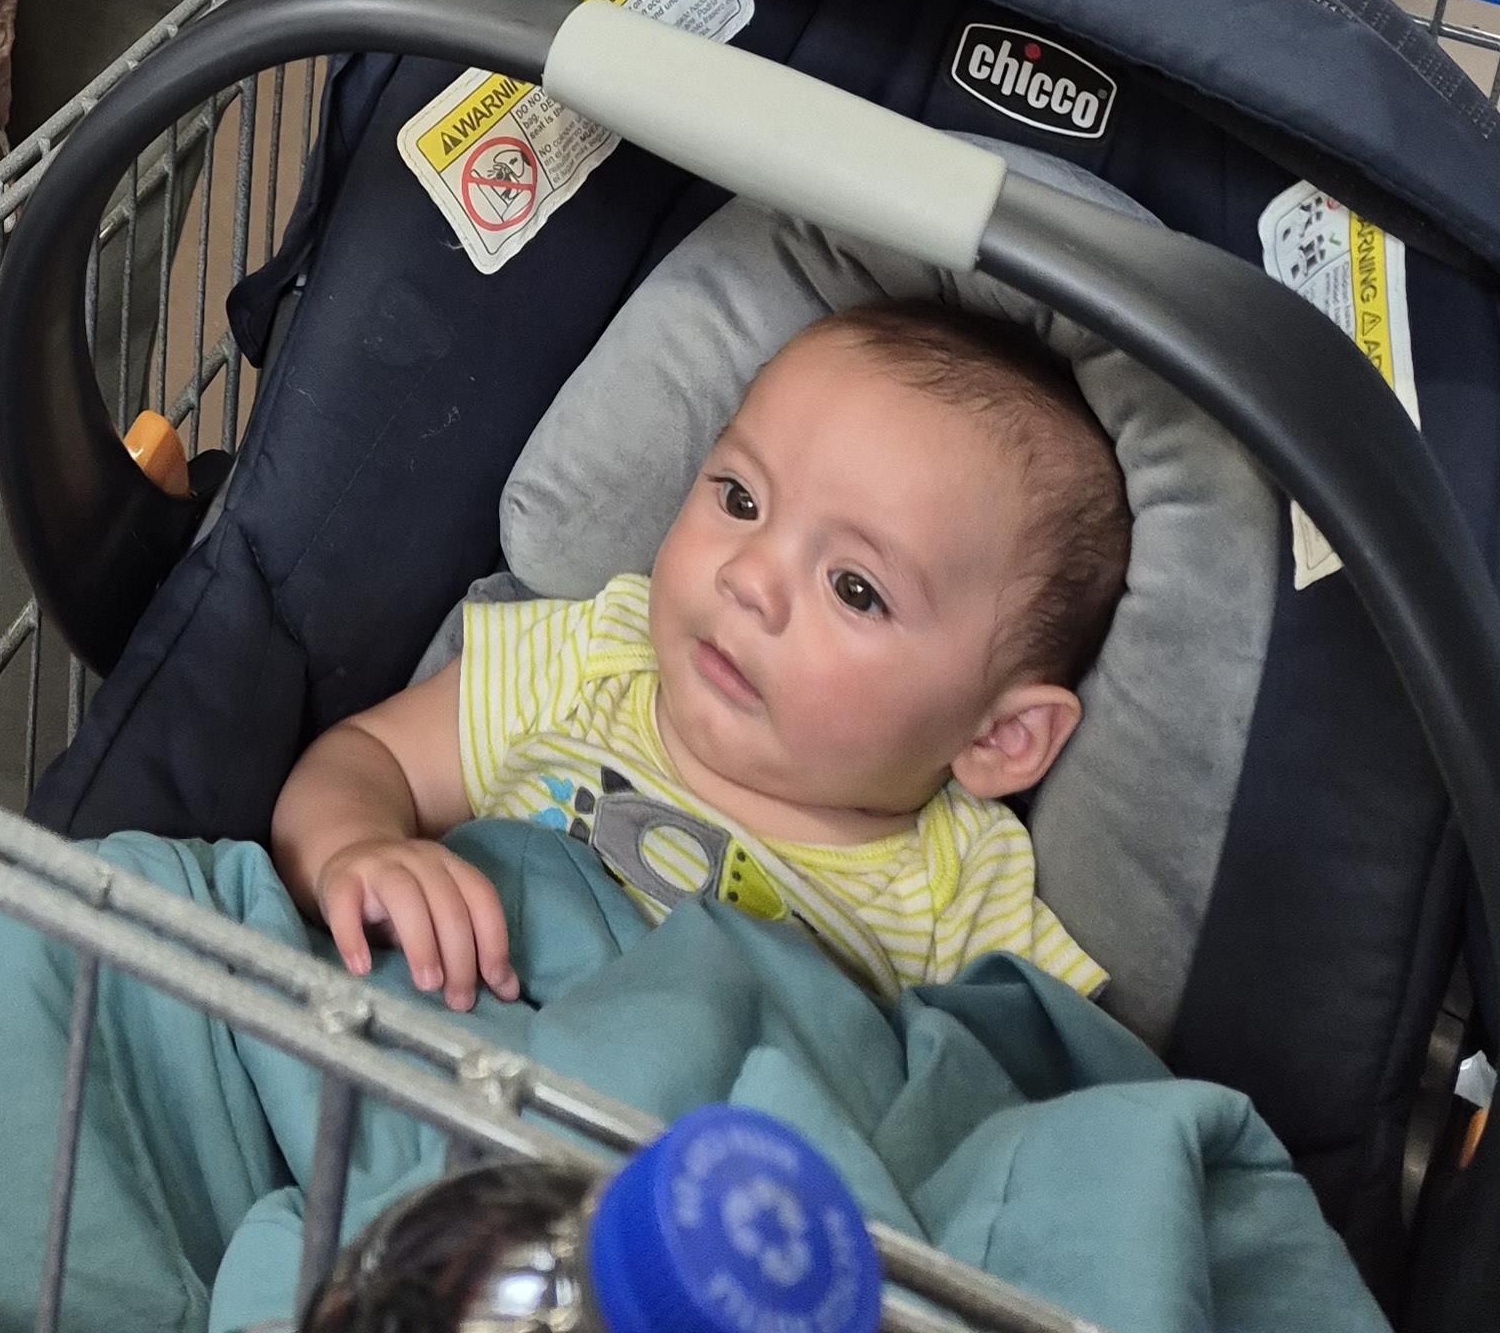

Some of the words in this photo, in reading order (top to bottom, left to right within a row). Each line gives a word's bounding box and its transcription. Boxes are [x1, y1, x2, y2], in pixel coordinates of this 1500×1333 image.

[968, 40, 1099, 129] chicco
[515, 103, 529, 120] DO
[529, 89, 546, 107] NOT
[530, 122, 546, 140] seat
[545, 115, 554, 125] is
[539, 143, 552, 159] NO
[1356, 216, 1379, 305] ARNING
